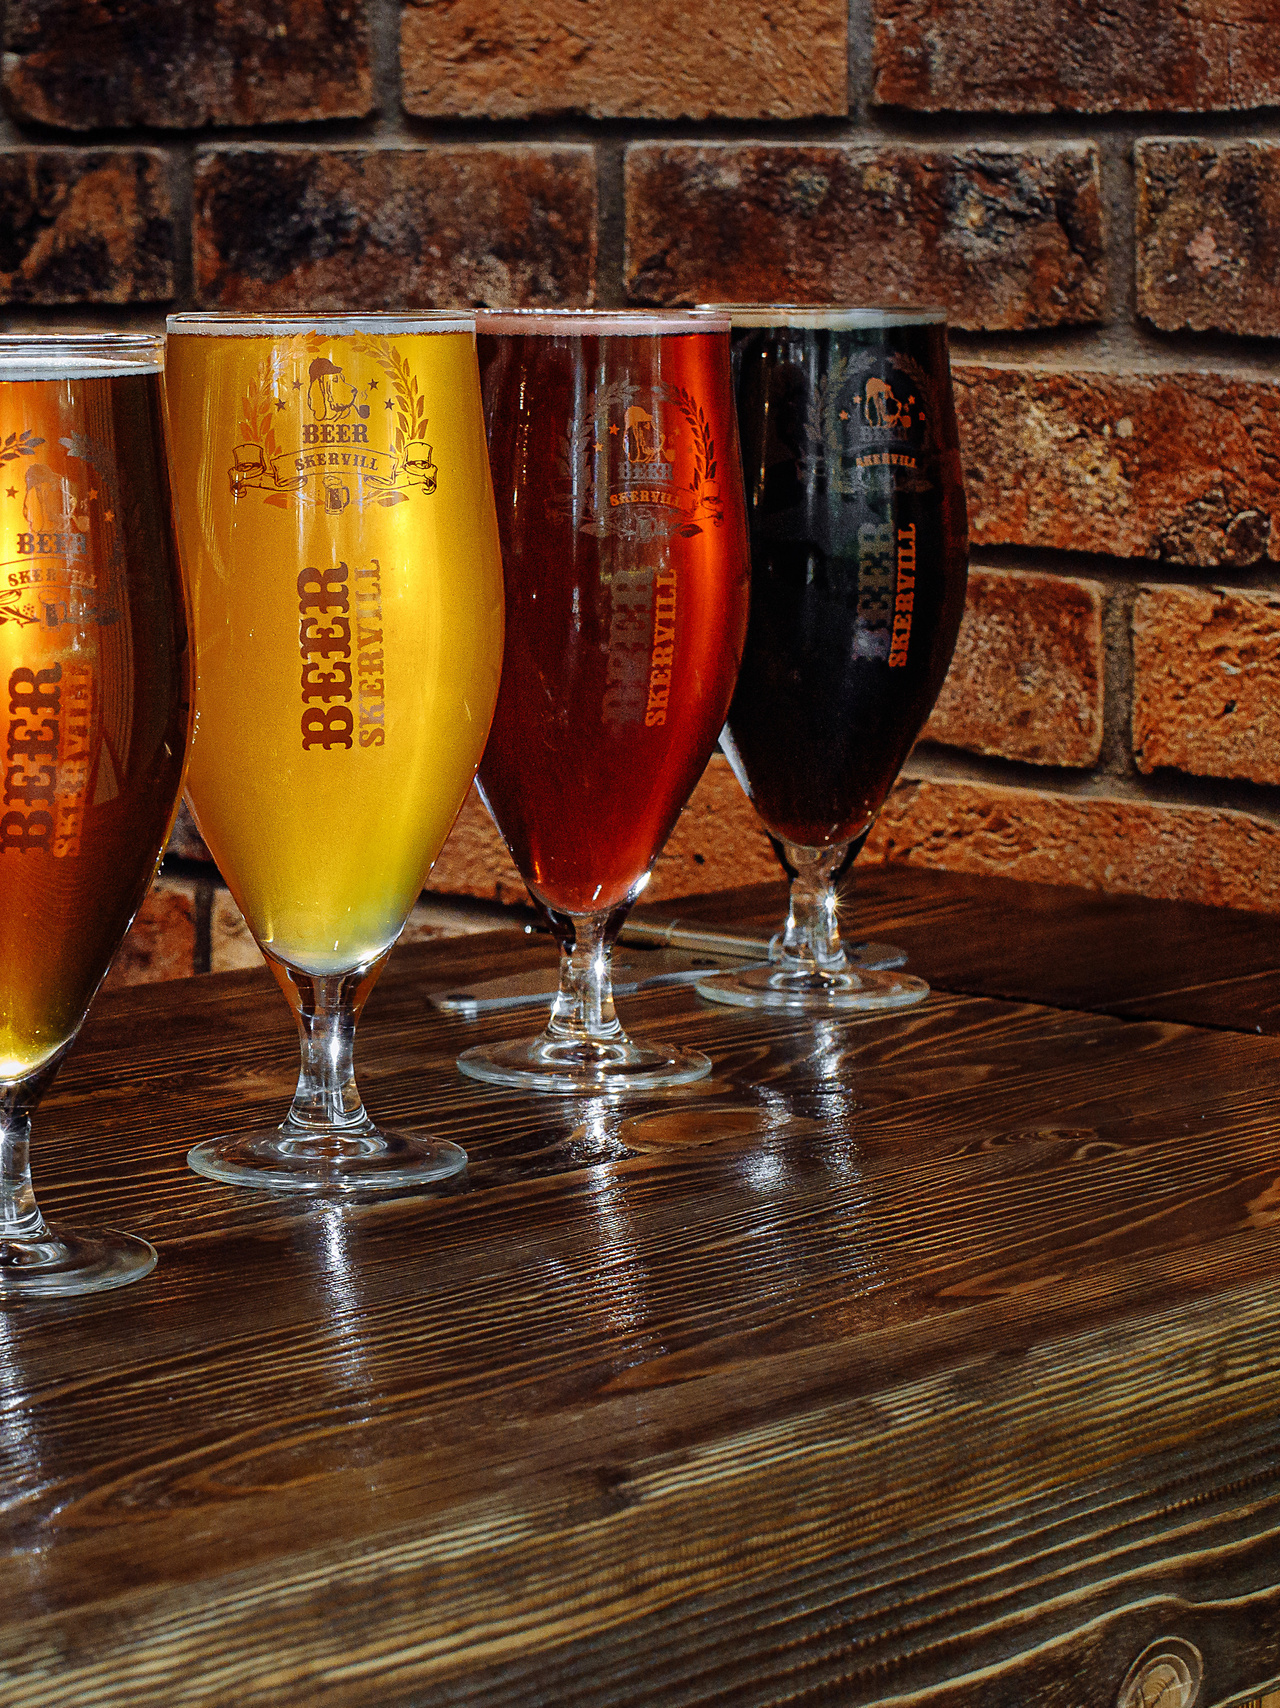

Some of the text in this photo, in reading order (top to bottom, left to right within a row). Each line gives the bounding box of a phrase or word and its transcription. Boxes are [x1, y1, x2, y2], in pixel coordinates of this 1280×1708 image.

[294, 452, 378, 471] SKERVILL
[302, 423, 369, 444] BEER
[17, 532, 87, 554] BEER
[888, 523, 916, 667] SKERVILL
[297, 561, 354, 750] BEER
[354, 559, 385, 748] SKERVILL
[645, 569, 677, 727] SKERVILL
[0, 661, 63, 854] BEER
